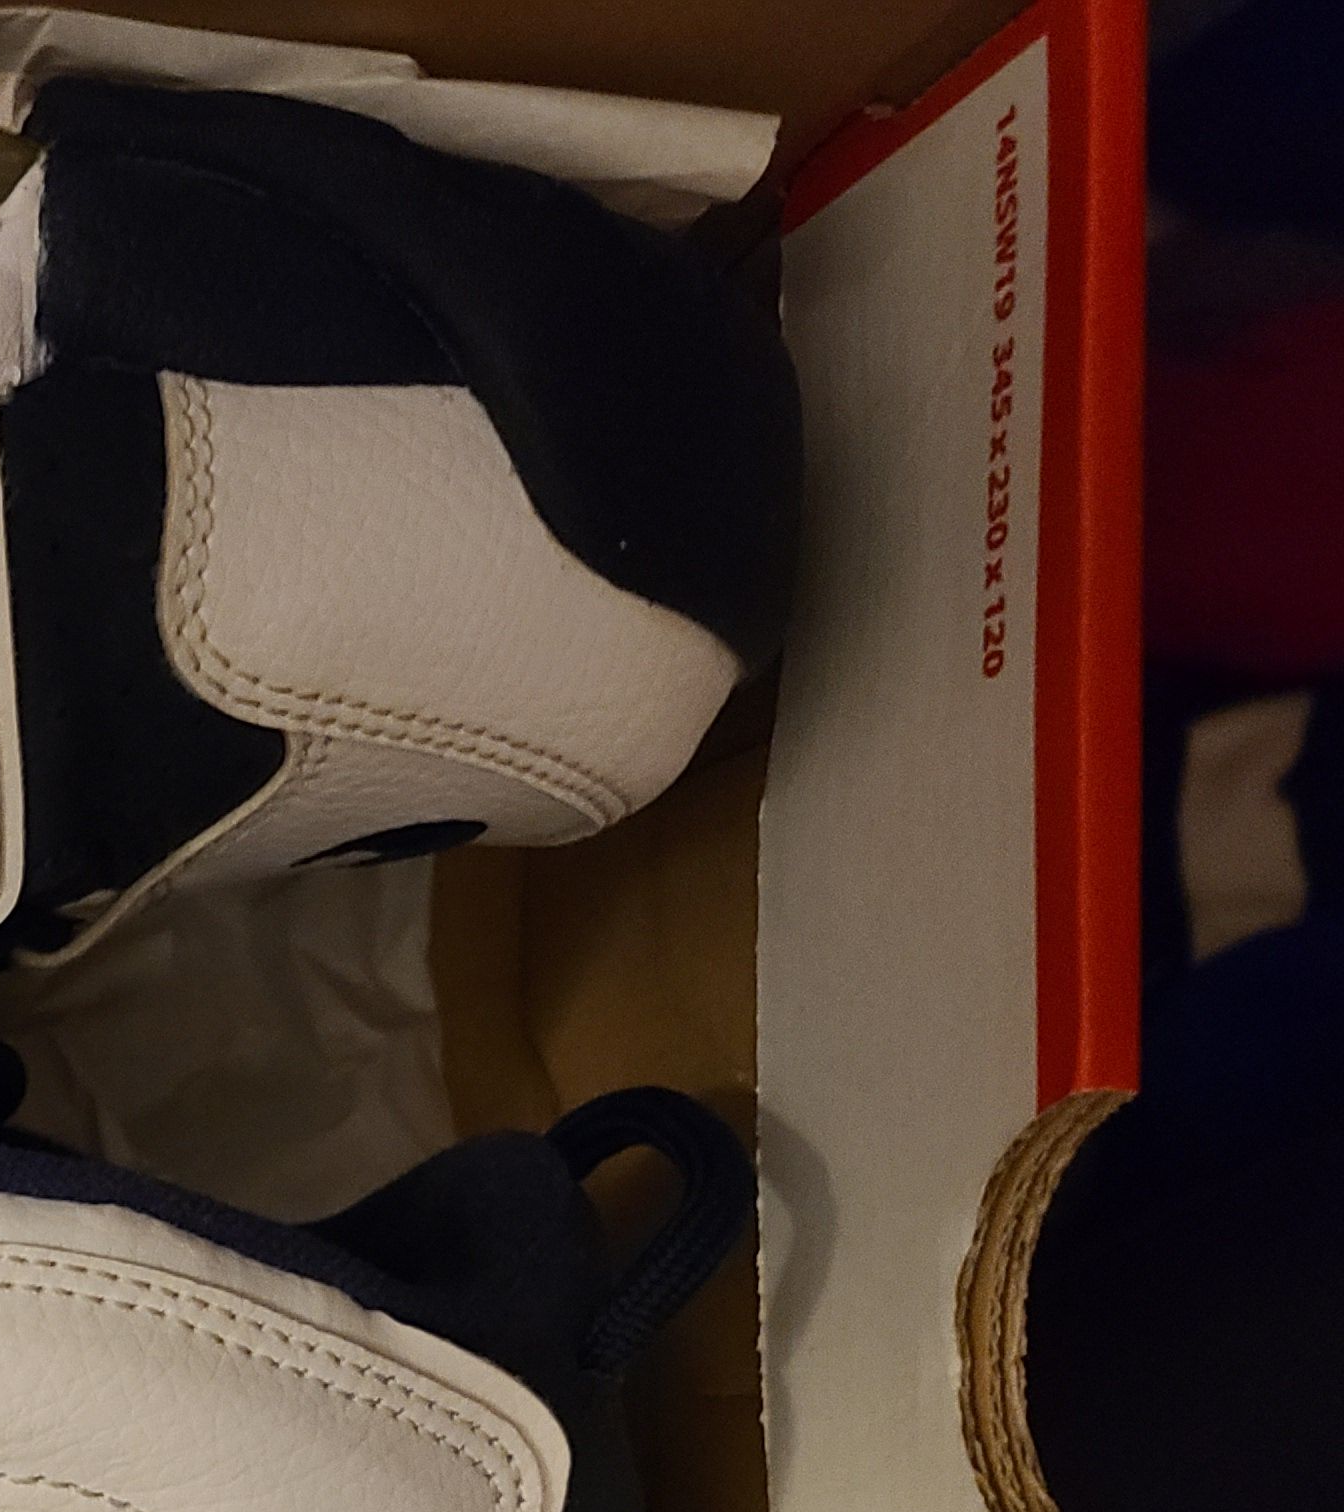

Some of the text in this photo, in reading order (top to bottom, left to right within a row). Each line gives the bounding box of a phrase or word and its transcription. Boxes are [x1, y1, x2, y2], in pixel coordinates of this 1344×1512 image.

[994, 103, 1018, 322] 14NSW19
[991, 335, 1014, 422] 345
[985, 464, 1011, 551] 230
[982, 596, 1006, 679] 120
